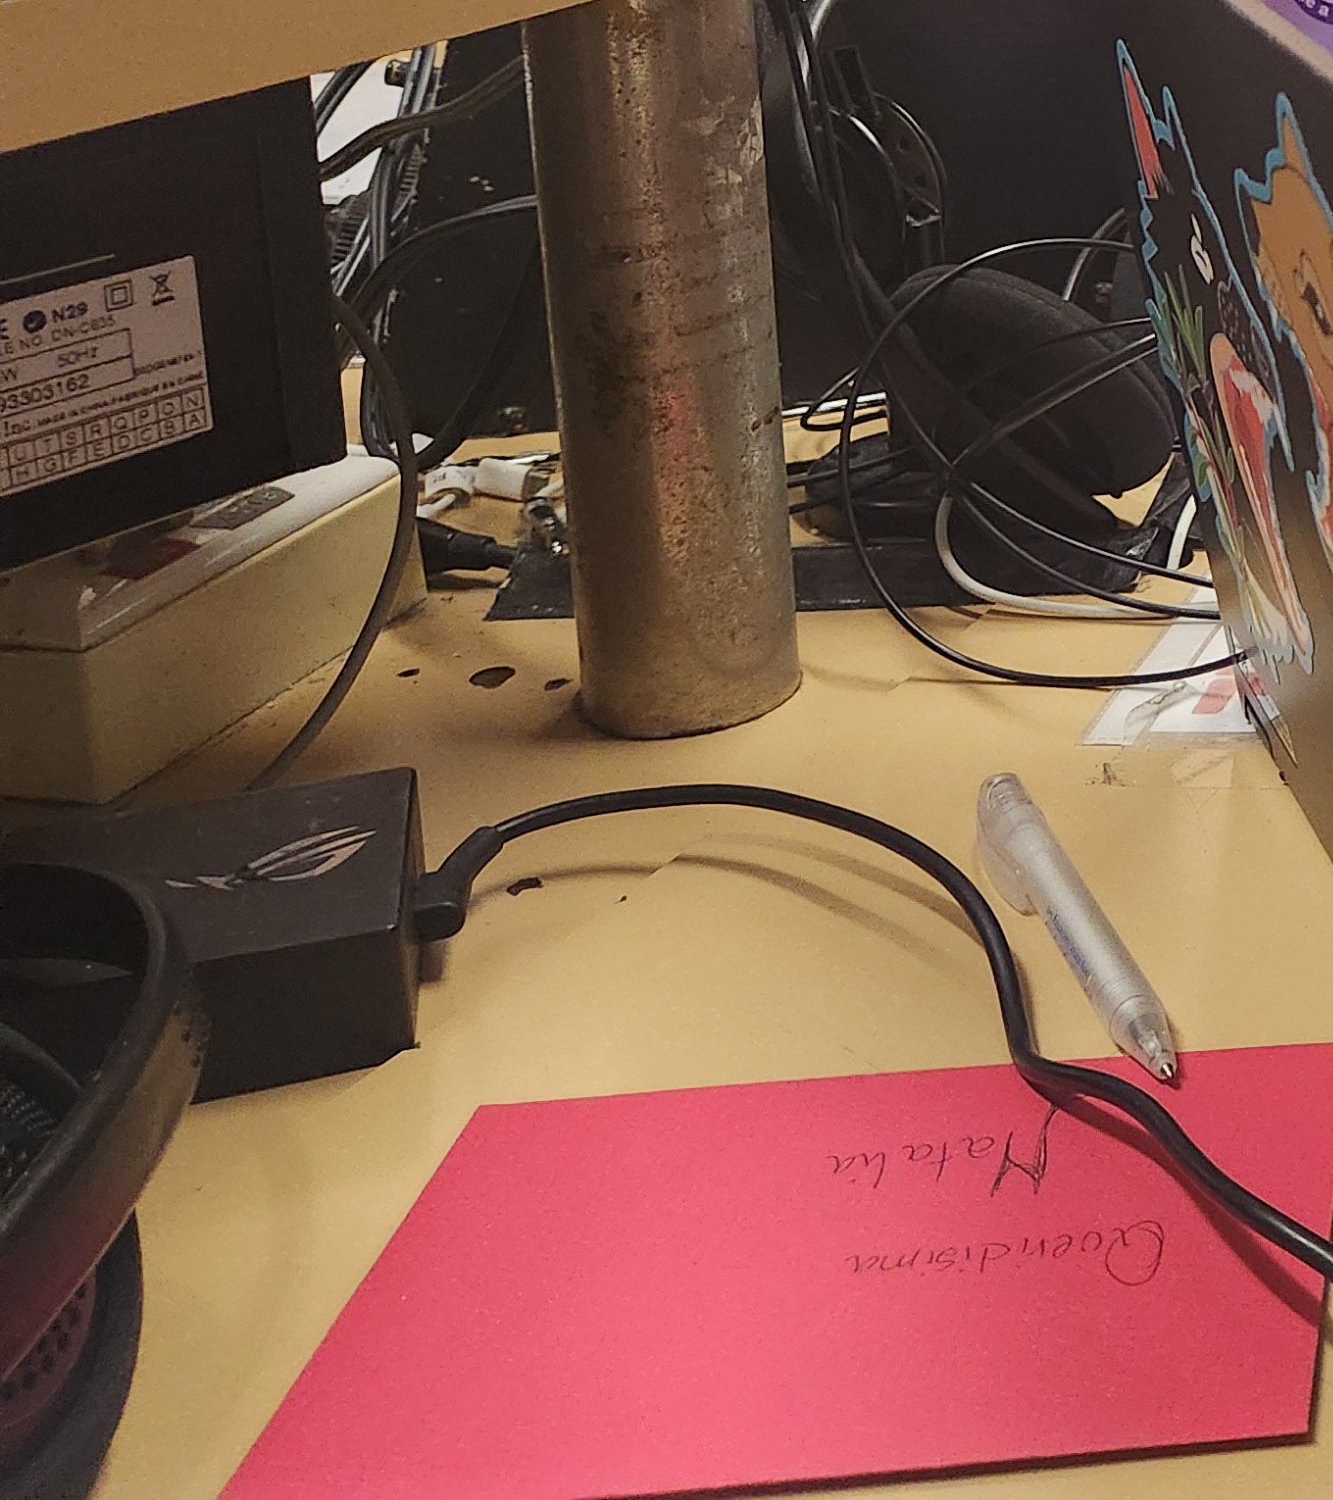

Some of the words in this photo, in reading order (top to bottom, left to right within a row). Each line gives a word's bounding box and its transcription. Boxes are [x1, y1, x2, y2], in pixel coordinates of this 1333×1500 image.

[51, 301, 89, 324] N29
[43, 458, 57, 473] G
[94, 443, 107, 458] E
[118, 435, 132, 450] D
[140, 427, 154, 442] C
[186, 414, 202, 428] A
[66, 431, 78, 446] S
[90, 423, 104, 437] R
[114, 416, 130, 431] Q
[138, 409, 150, 424] P
[187, 395, 200, 408] N
[825, 1101, 1062, 1198] Natalia
